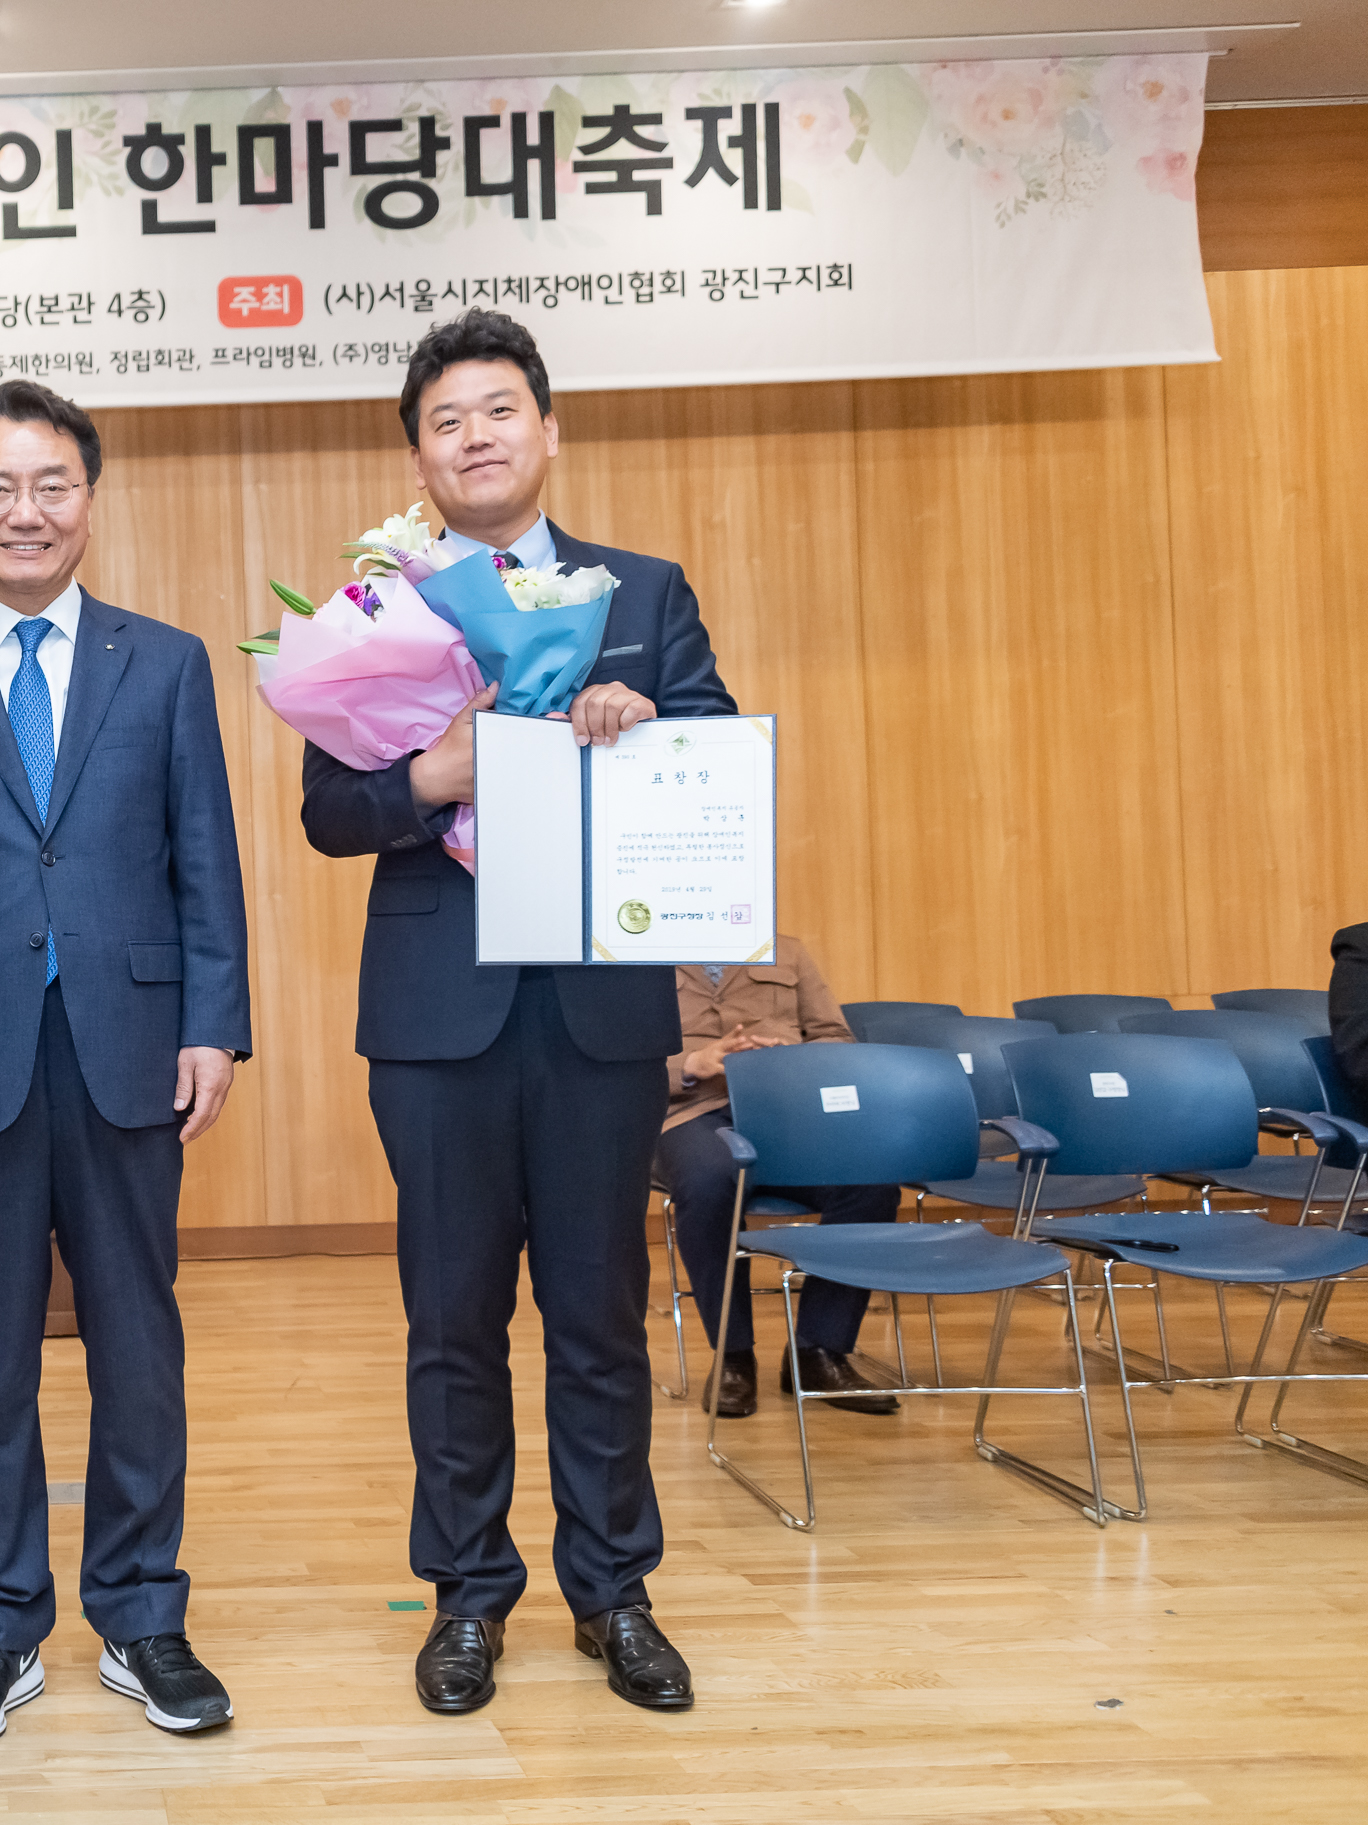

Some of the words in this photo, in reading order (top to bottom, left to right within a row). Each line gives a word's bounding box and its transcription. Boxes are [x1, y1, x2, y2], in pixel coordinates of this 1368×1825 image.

[123, 101, 782, 235] 한마당대축제
[107, 288, 167, 324] 4층)
[228, 282, 291, 317] 주최
[323, 269, 685, 314] (사)서울시지체장애인협회
[700, 262, 853, 301] 광진구지회
[109, 347, 201, 375] 정립회관,
[210, 343, 324, 370] 프라임병원,
[333, 341, 421, 366] (주)영남
